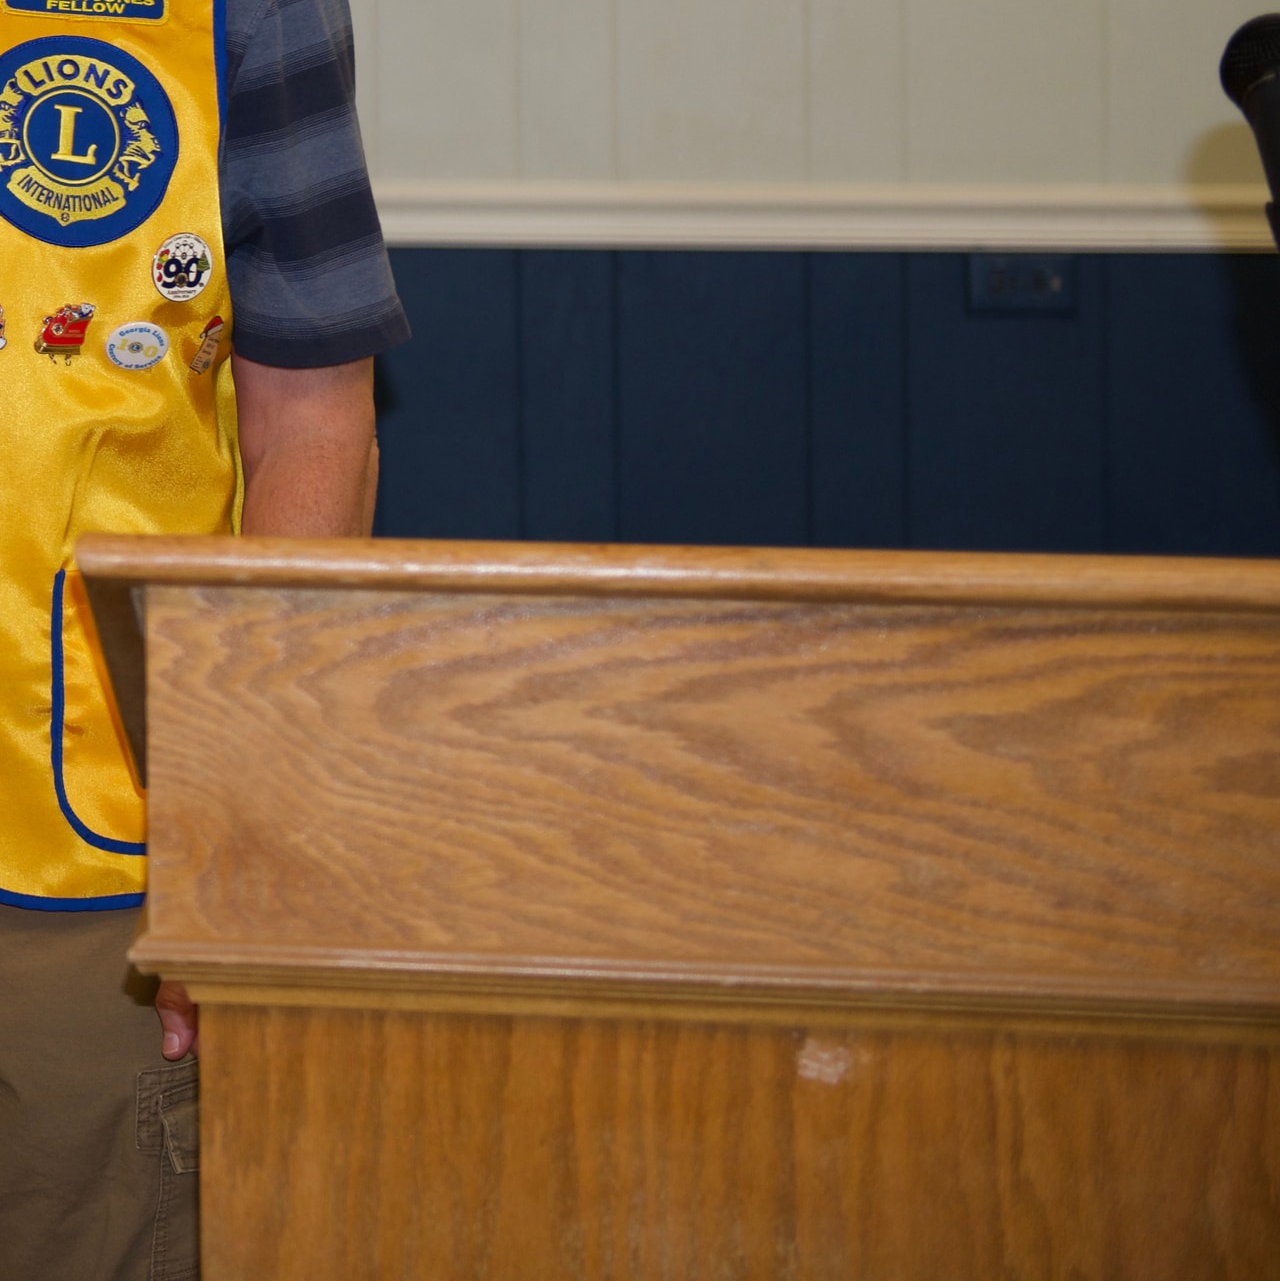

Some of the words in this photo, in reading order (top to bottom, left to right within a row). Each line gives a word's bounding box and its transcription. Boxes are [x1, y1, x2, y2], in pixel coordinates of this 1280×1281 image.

[46, 0, 126, 14] FELLOW
[23, 58, 129, 100] LIONS
[51, 103, 98, 165] L
[17, 173, 120, 212] INTERNATIONAL
[161, 257, 202, 289] 90
[119, 327, 151, 337] Georgia
[108, 343, 124, 366] Century
[134, 355, 161, 369] Service
